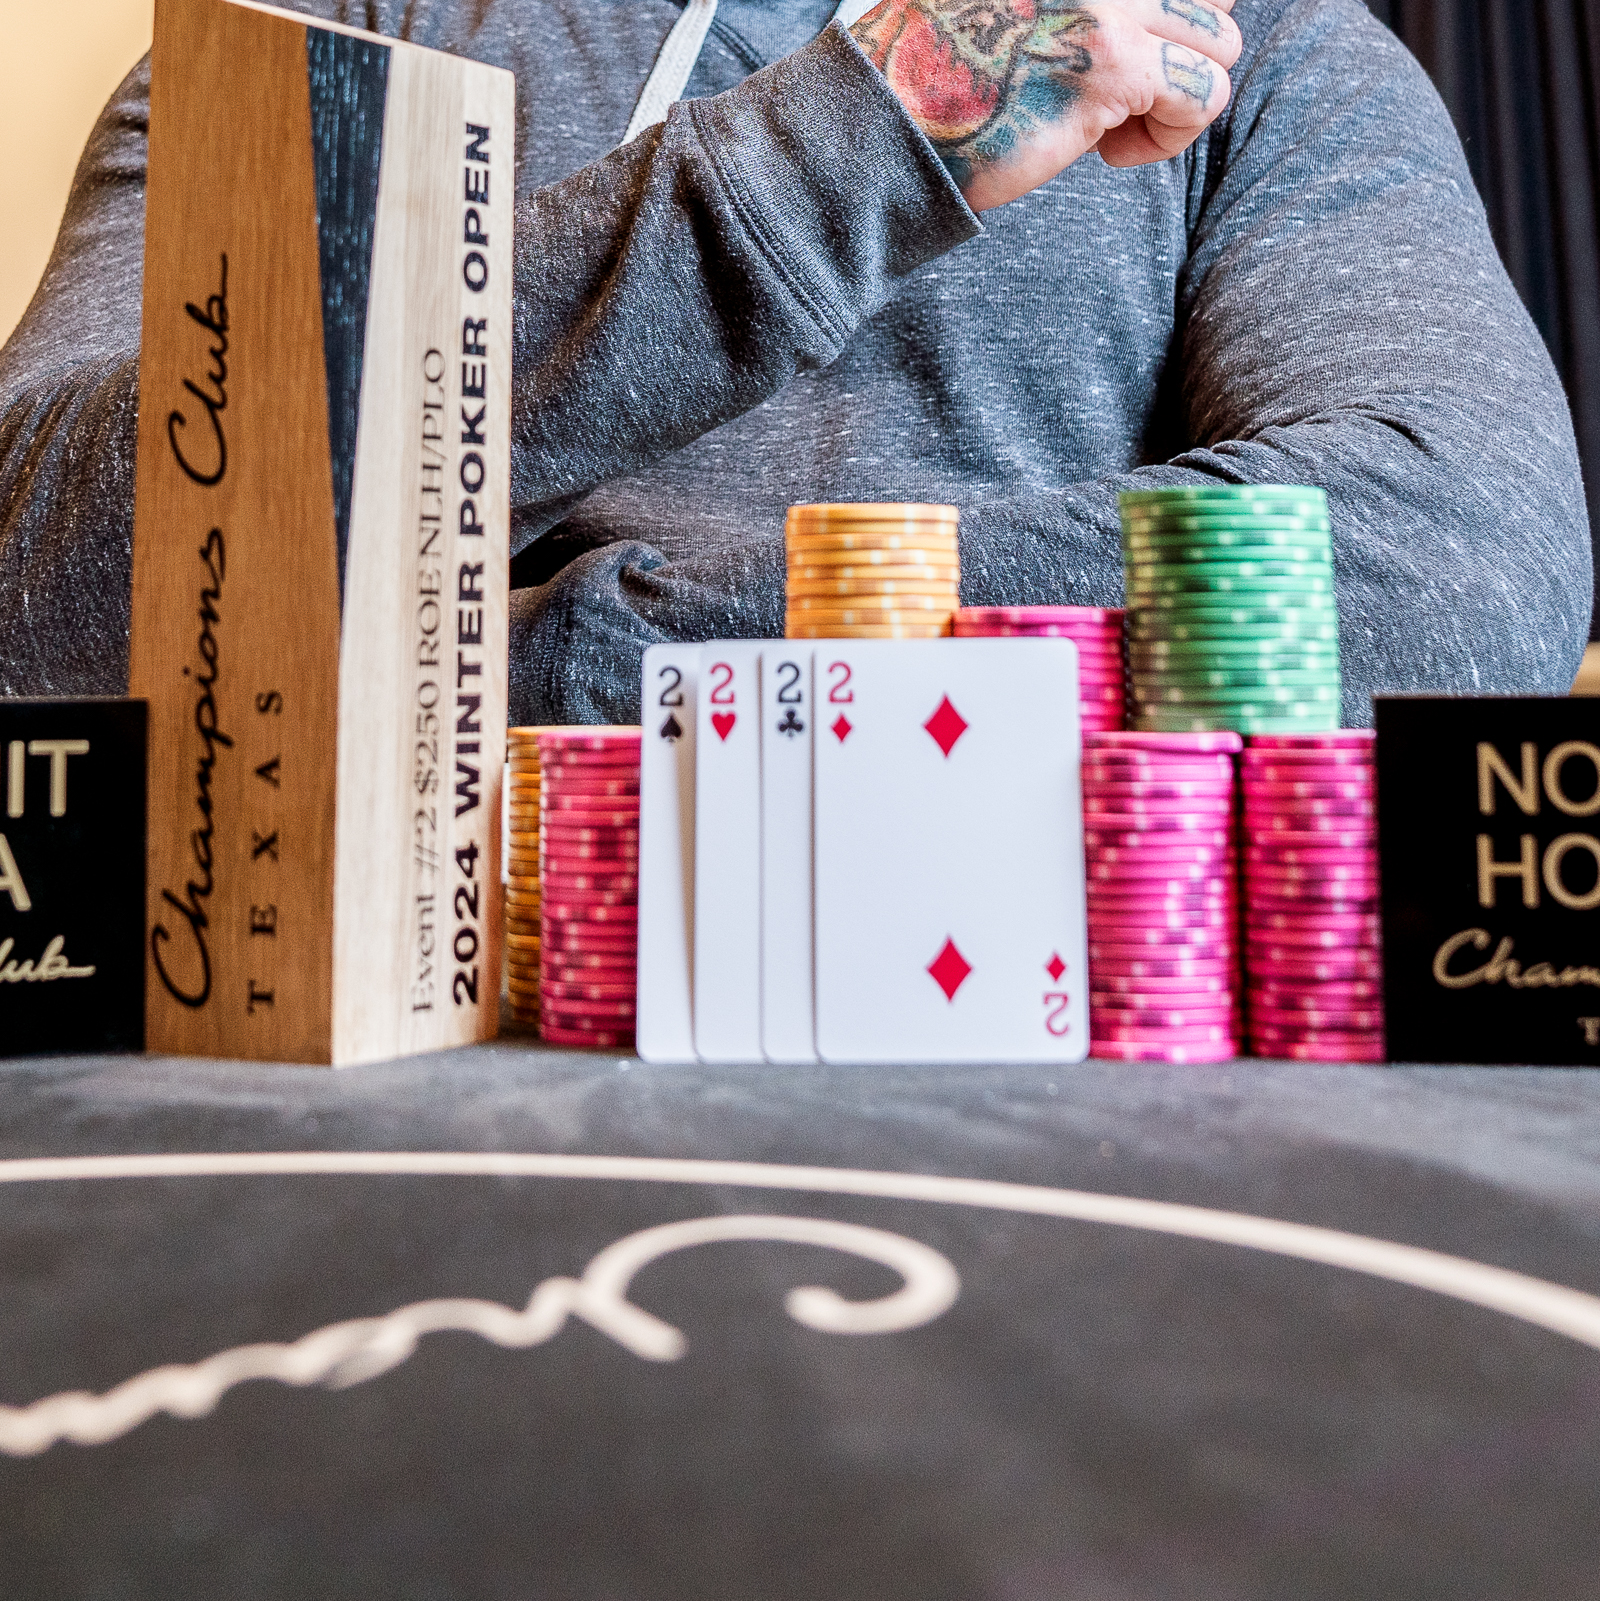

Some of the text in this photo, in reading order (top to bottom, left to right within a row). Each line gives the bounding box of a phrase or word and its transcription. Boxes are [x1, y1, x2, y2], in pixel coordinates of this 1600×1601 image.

[454, 121, 491, 1007] 2024 WINTER POKER OPEN
[152, 253, 235, 1008] Champions Club
[412, 348, 446, 1015] Event #2 $250 ROE NLH/PLO
[658, 665, 684, 707] 2
[709, 661, 736, 704] 2
[777, 661, 803, 704] 2
[827, 661, 855, 704] 2
[247, 689, 283, 1016] TEXAS
[1043, 992, 1071, 1038] 2
